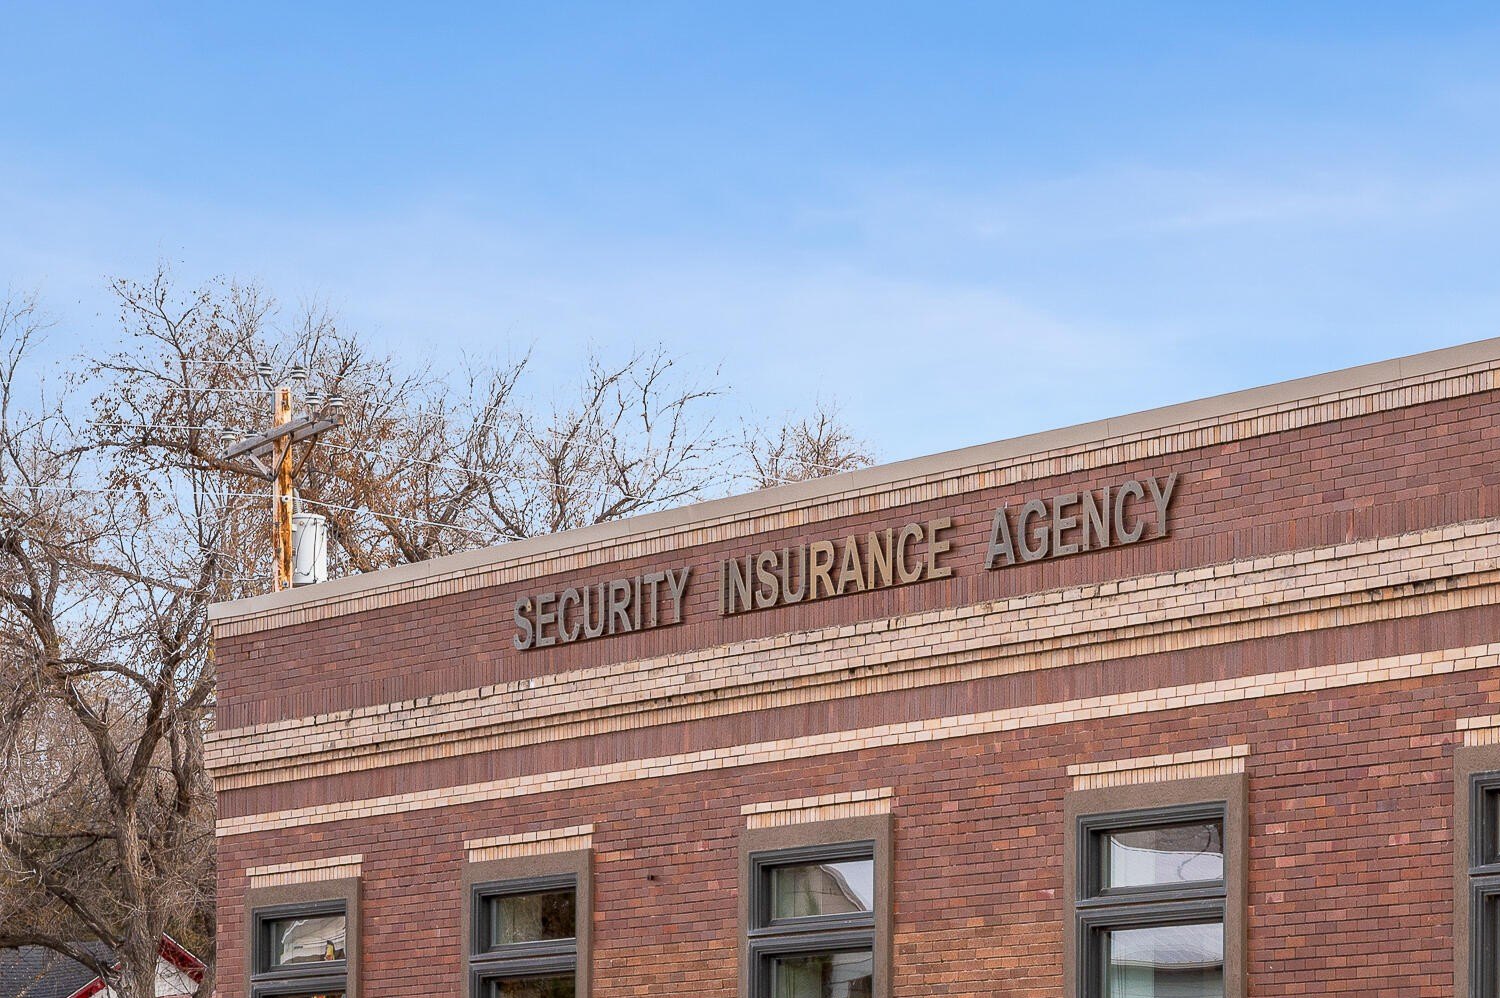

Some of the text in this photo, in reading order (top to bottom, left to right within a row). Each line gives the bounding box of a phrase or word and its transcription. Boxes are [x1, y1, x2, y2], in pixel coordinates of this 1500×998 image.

[513, 472, 1179, 652] SECURITY INSURANCE AGENCY
